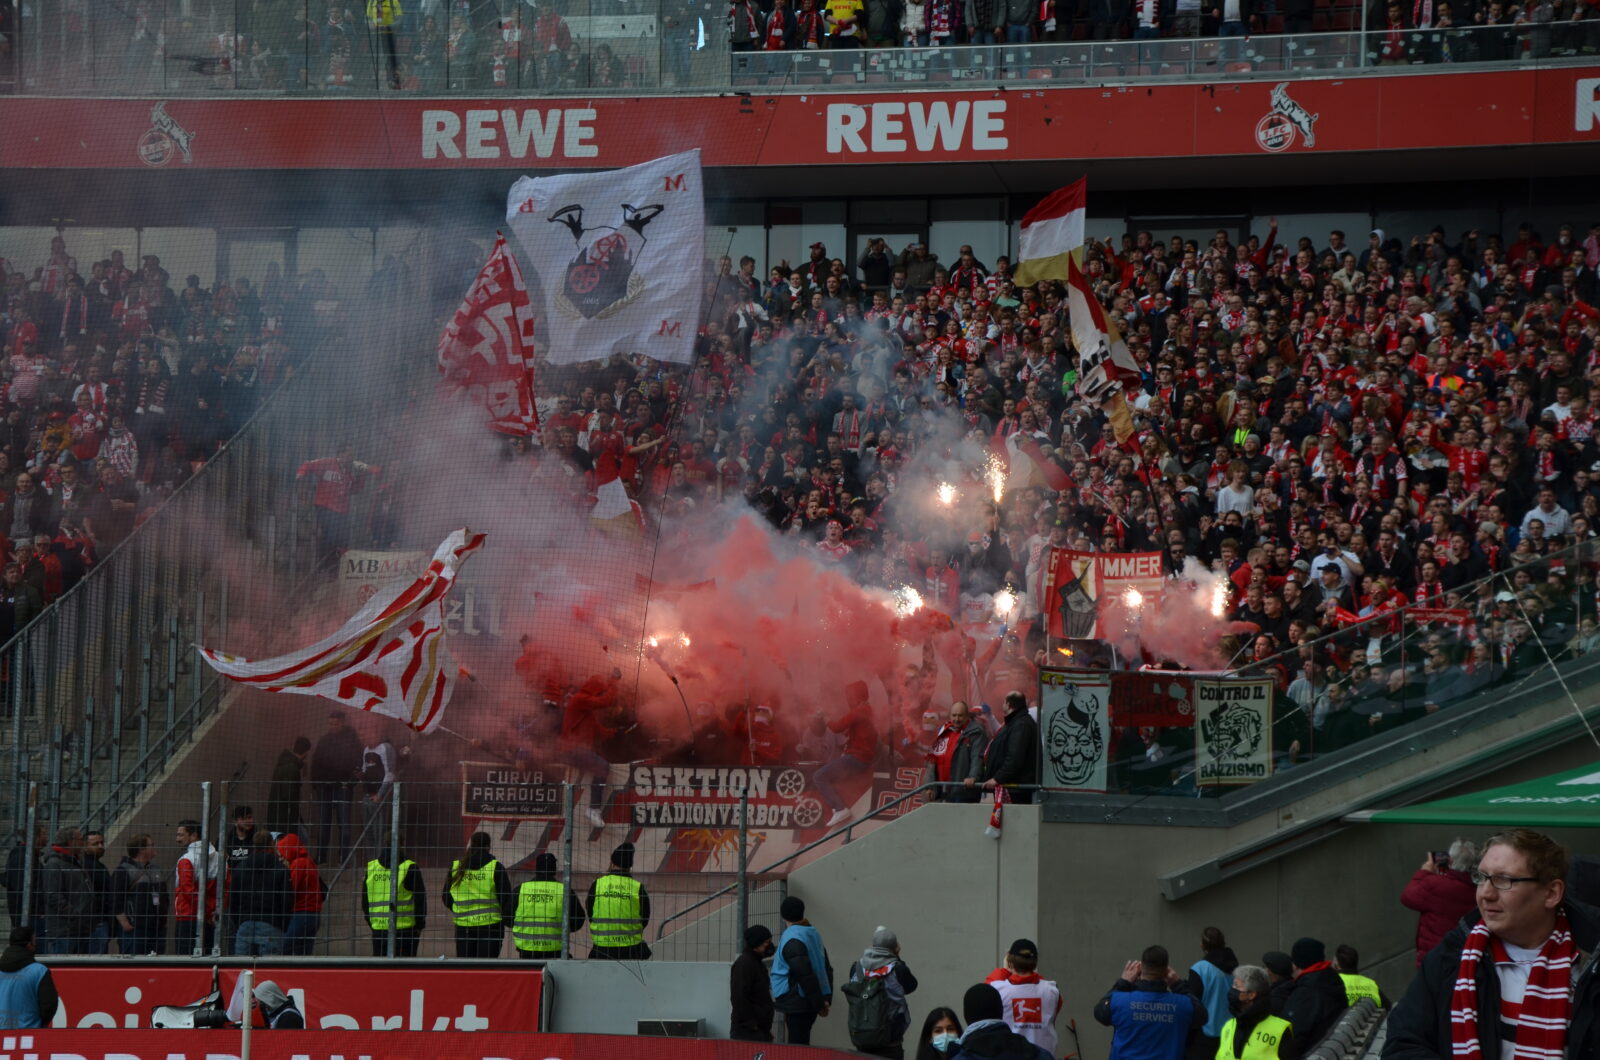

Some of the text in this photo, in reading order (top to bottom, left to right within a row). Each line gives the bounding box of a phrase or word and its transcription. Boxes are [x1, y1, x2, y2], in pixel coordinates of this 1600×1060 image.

[421, 108, 599, 159] REWE
[826, 99, 1009, 153] REWE
[1200, 685, 1251, 701] CONTRO
[1253, 685, 1265, 699] IL
[486, 770, 543, 785] CURVA
[1200, 762, 1265, 778] RAZZISMO
[633, 766, 771, 799] SEKTION
[472, 787, 557, 802] PARADISO
[635, 801, 794, 827] STADIONVERBOT
[526, 894, 554, 904] ORDNER
[1129, 1000, 1177, 1013] SECURITY
[1132, 1011, 1174, 1024] SERVICE
[1256, 1031, 1277, 1046] 100
